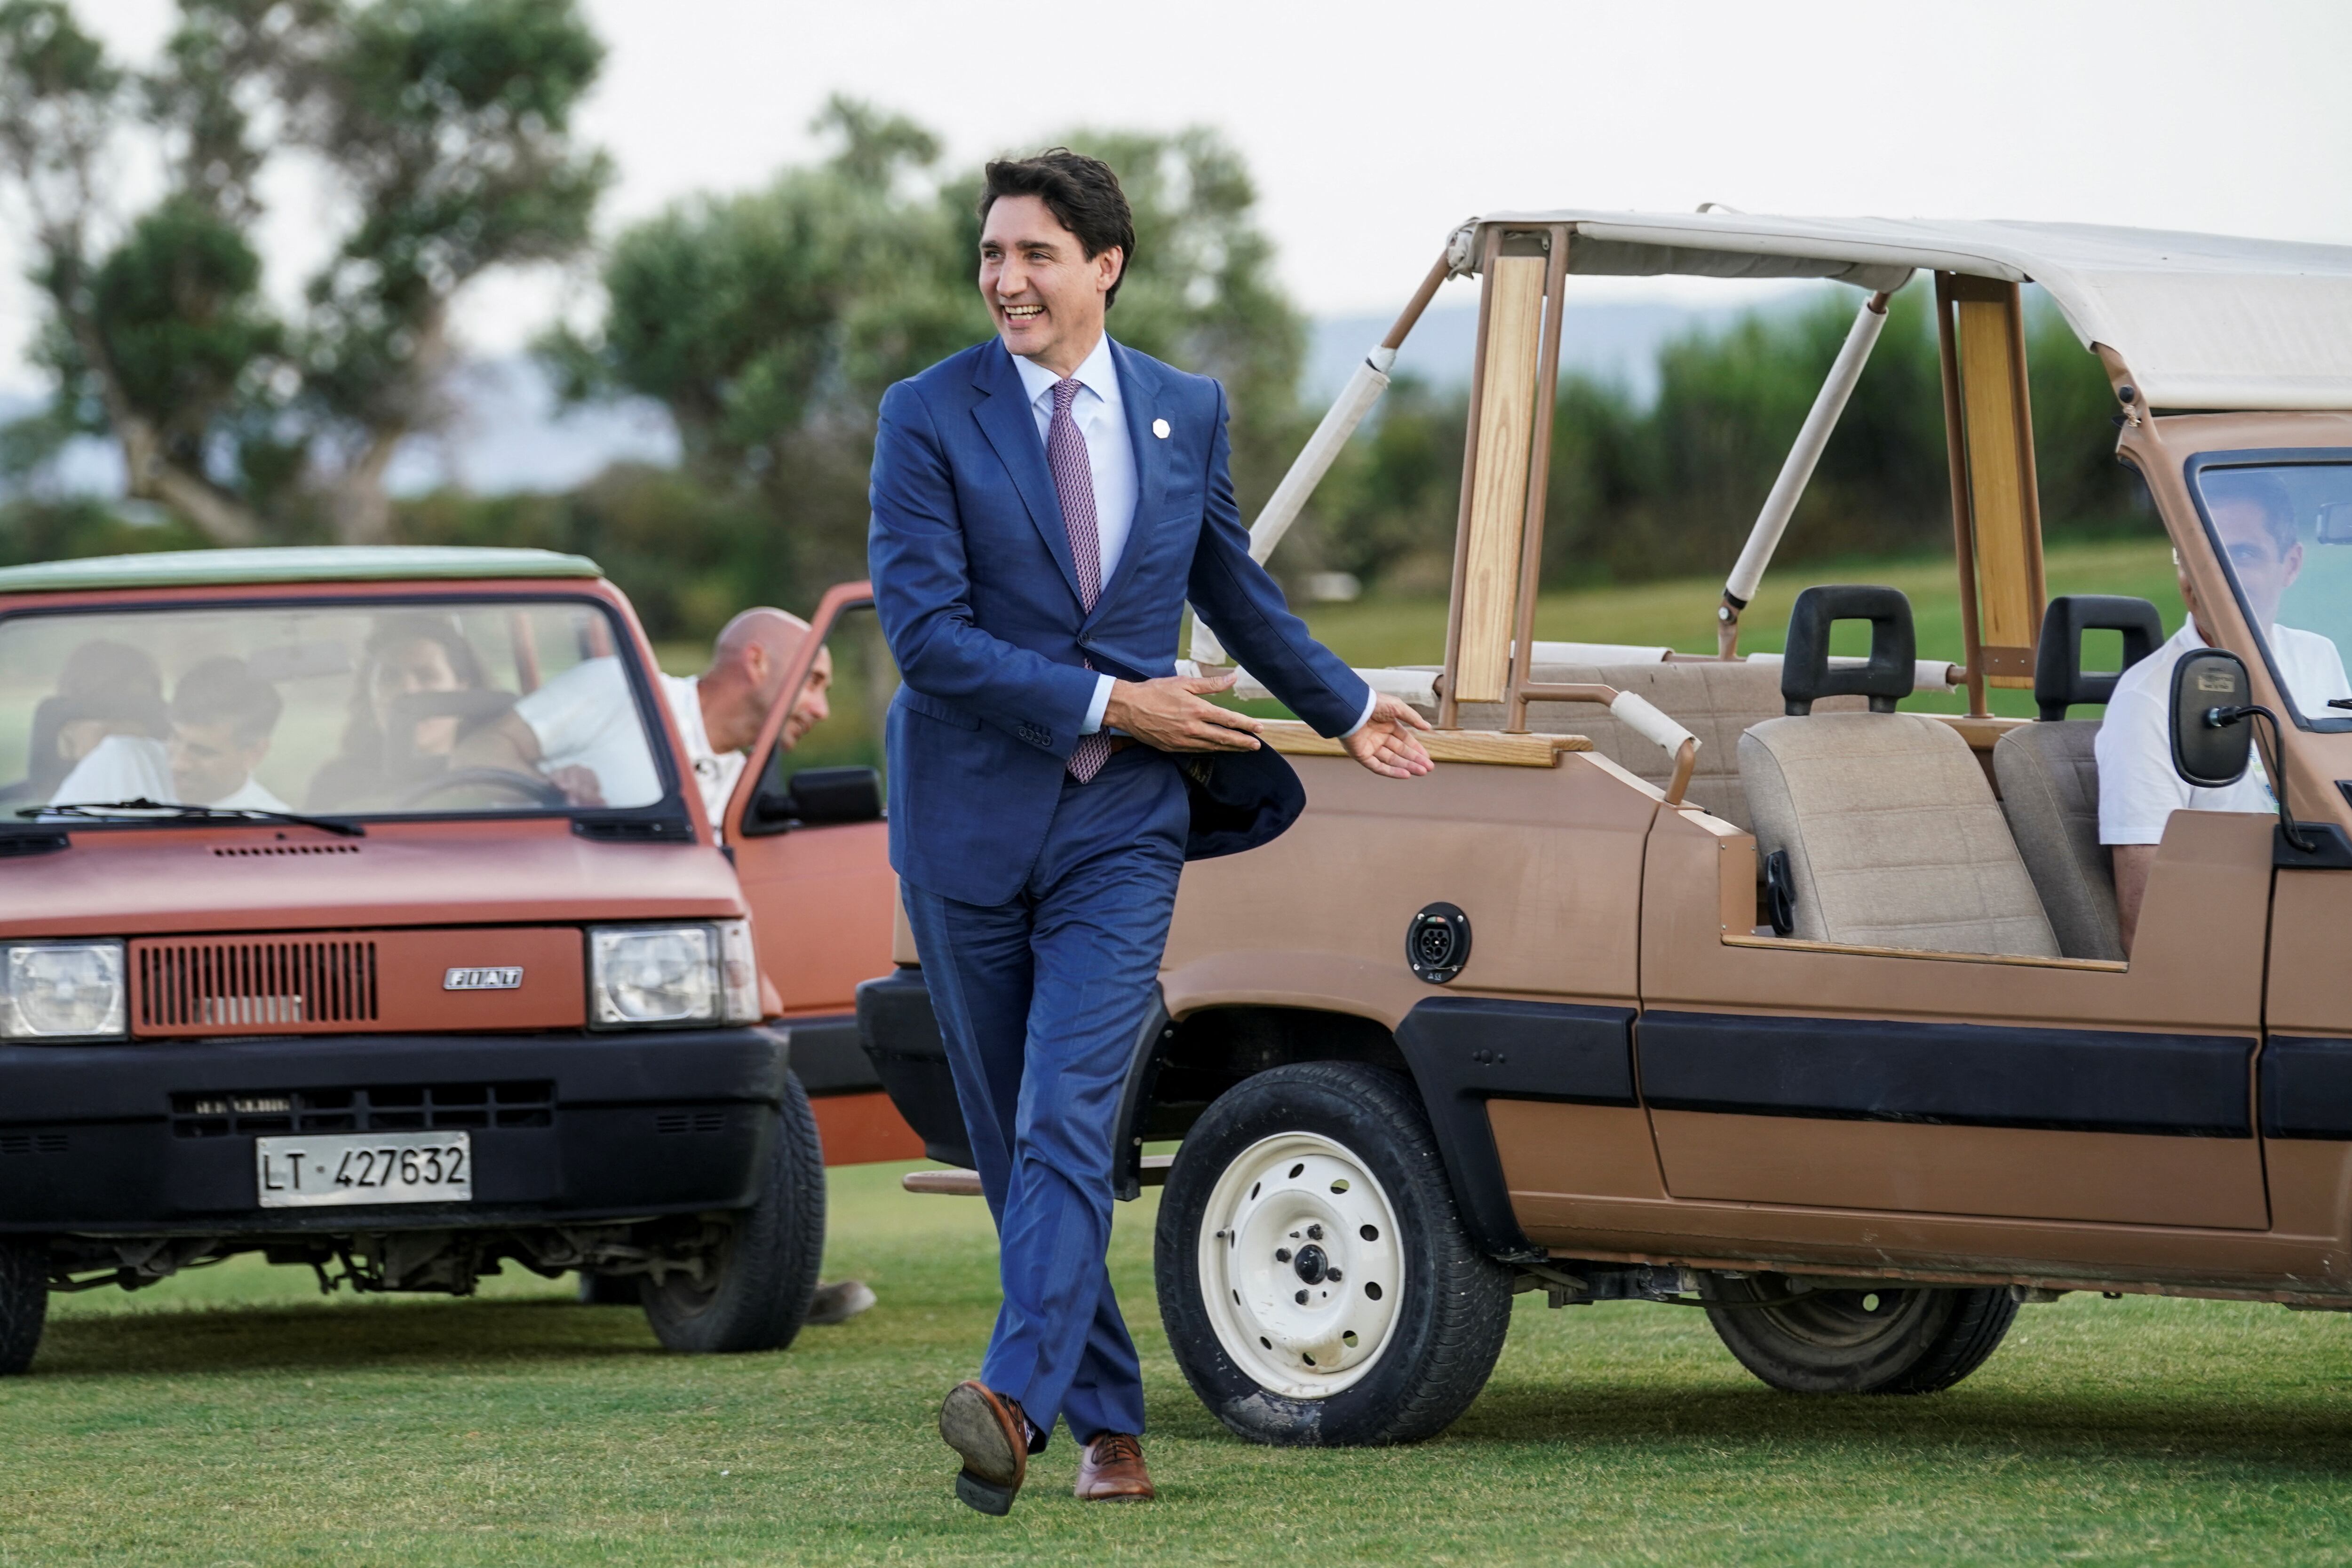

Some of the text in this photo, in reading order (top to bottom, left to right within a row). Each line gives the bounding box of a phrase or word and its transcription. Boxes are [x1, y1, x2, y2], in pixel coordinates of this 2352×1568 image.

[449, 970, 519, 986] FIAT
[262, 1147, 466, 1190] LT 427632
